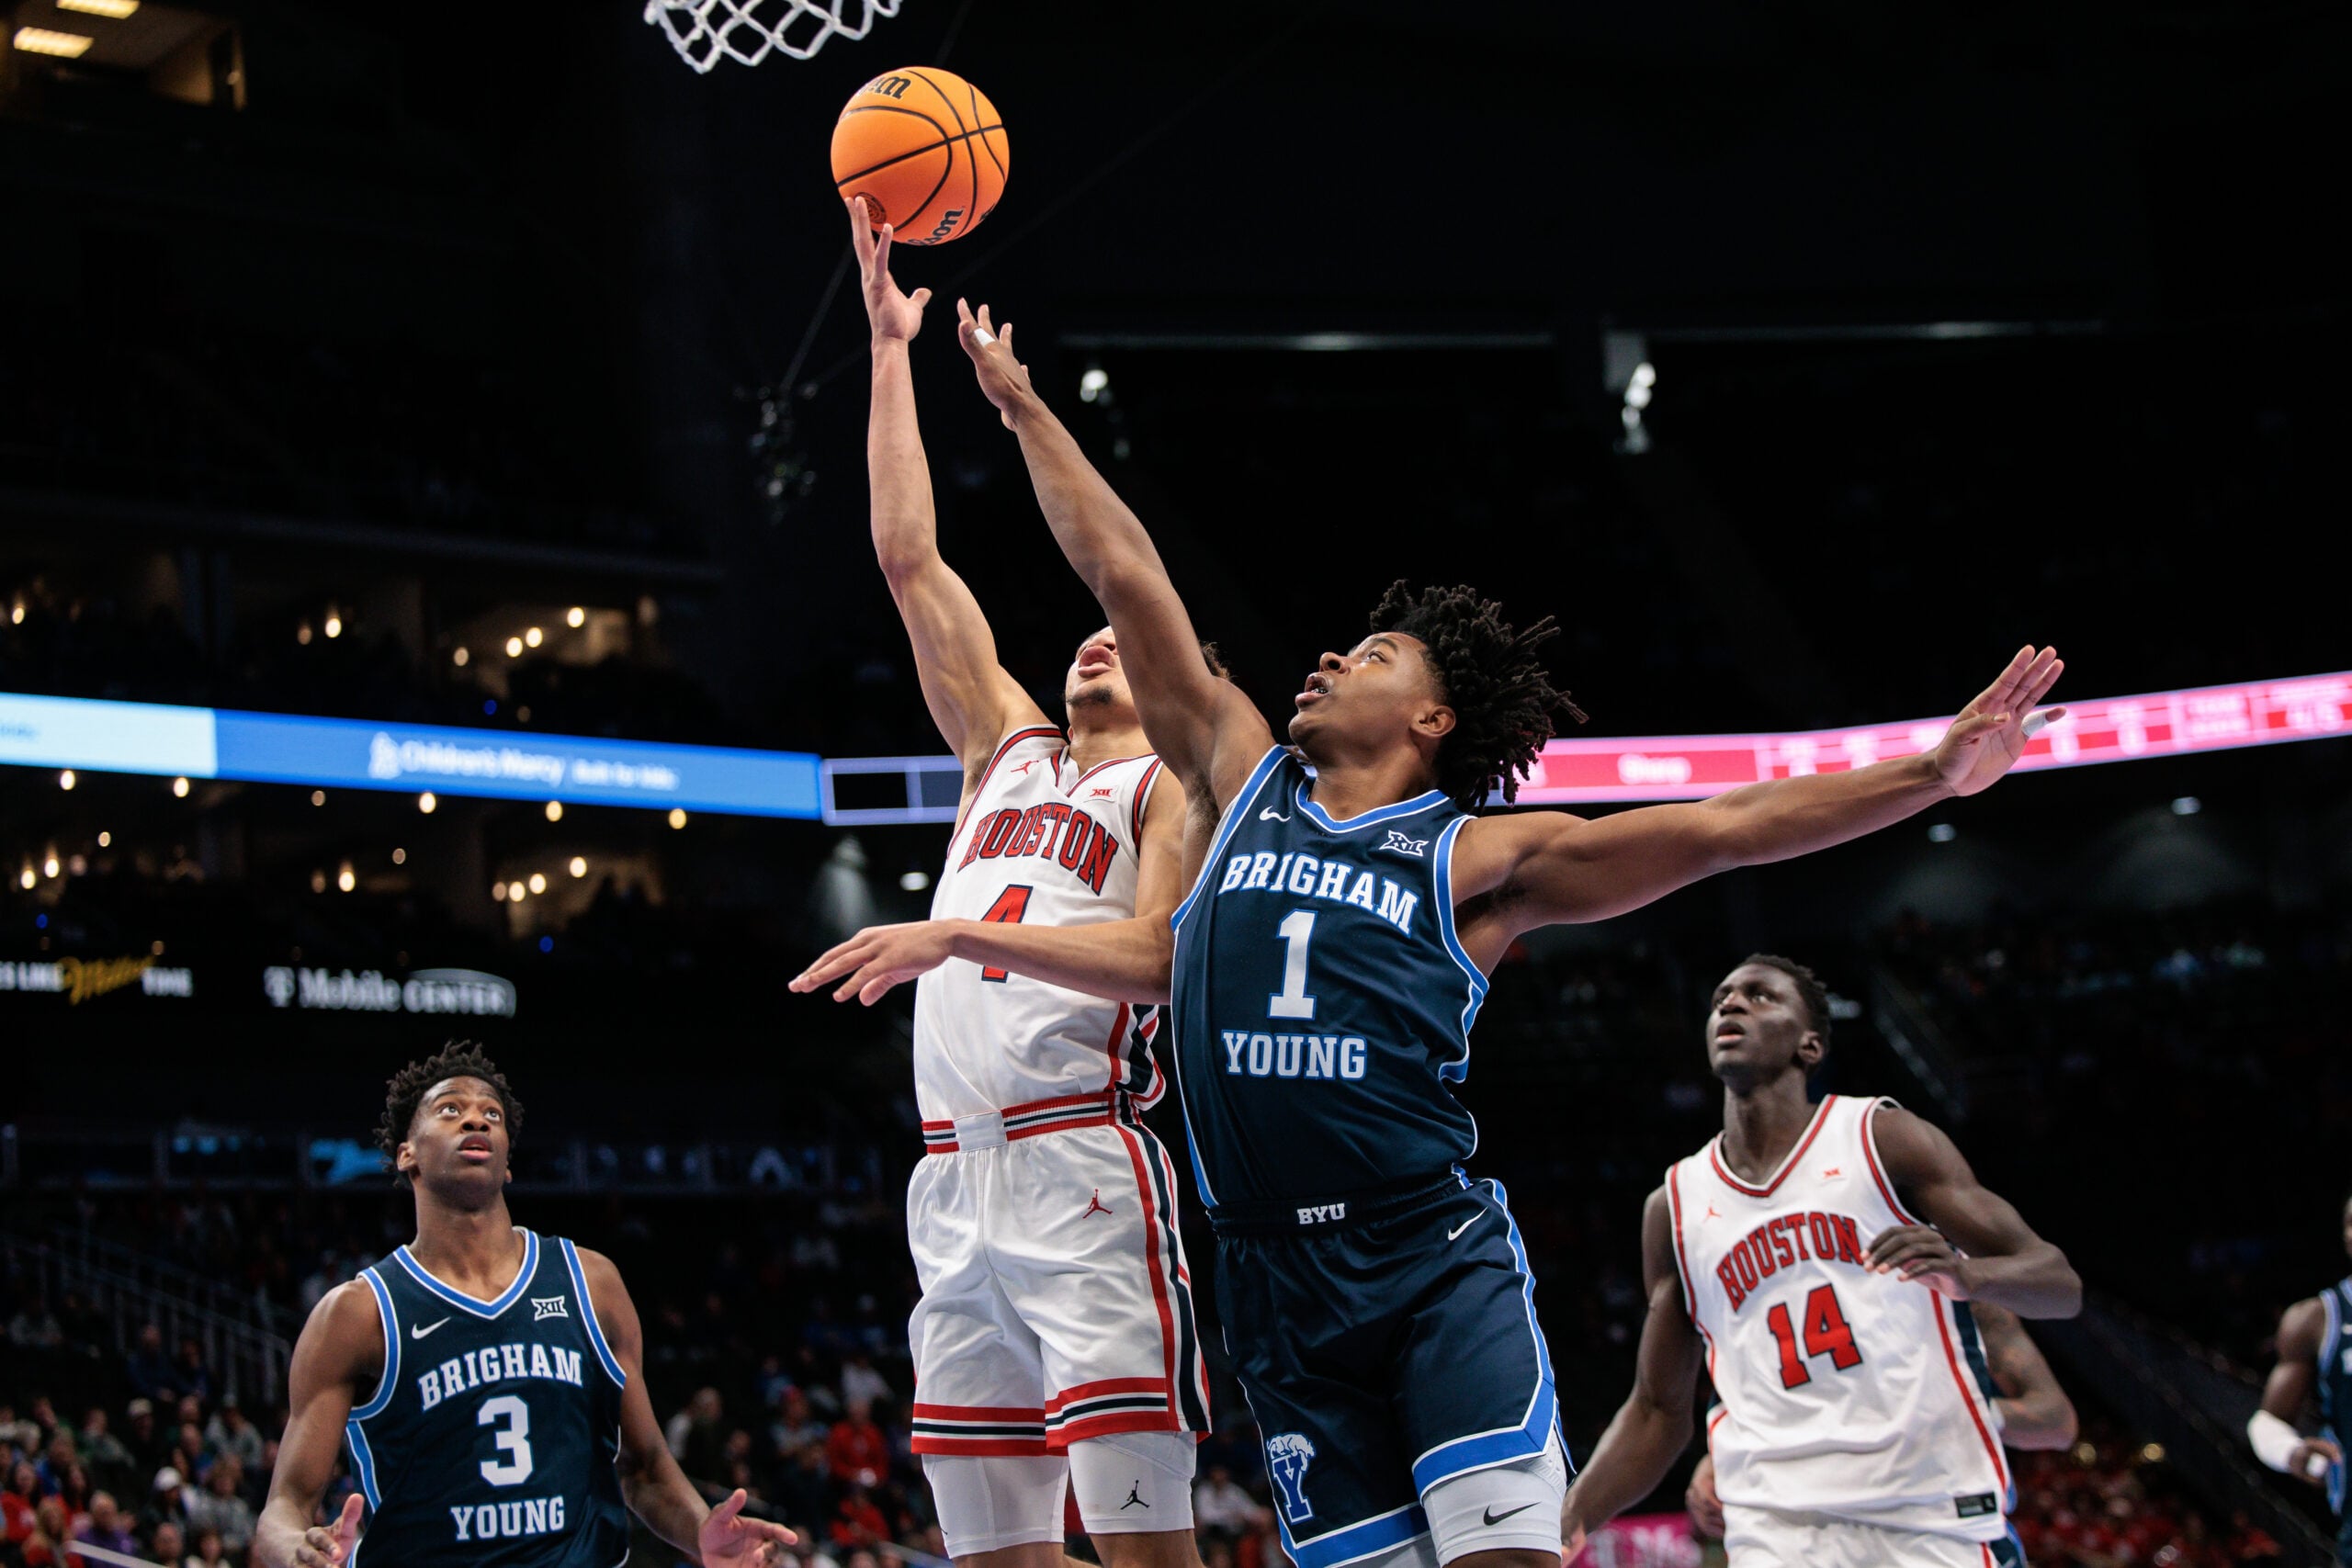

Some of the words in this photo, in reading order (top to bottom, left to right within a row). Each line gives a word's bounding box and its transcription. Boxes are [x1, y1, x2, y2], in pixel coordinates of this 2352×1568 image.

[956, 802, 1119, 897] HOUSTON
[1216, 850, 1419, 939] BRIGHAM
[299, 967, 401, 1010] Mobile
[402, 979, 508, 1015] CENTER
[1267, 908, 1318, 1021] 1
[1221, 1029, 1367, 1080] YOUNG
[1296, 1202, 1345, 1225] BYU
[1716, 1212, 1864, 1313] HOUSTON
[417, 1344, 583, 1412] BRIGHAM
[1767, 1282, 1863, 1390] 14
[477, 1394, 534, 1487] 3
[450, 1495, 566, 1541] YOUNG
